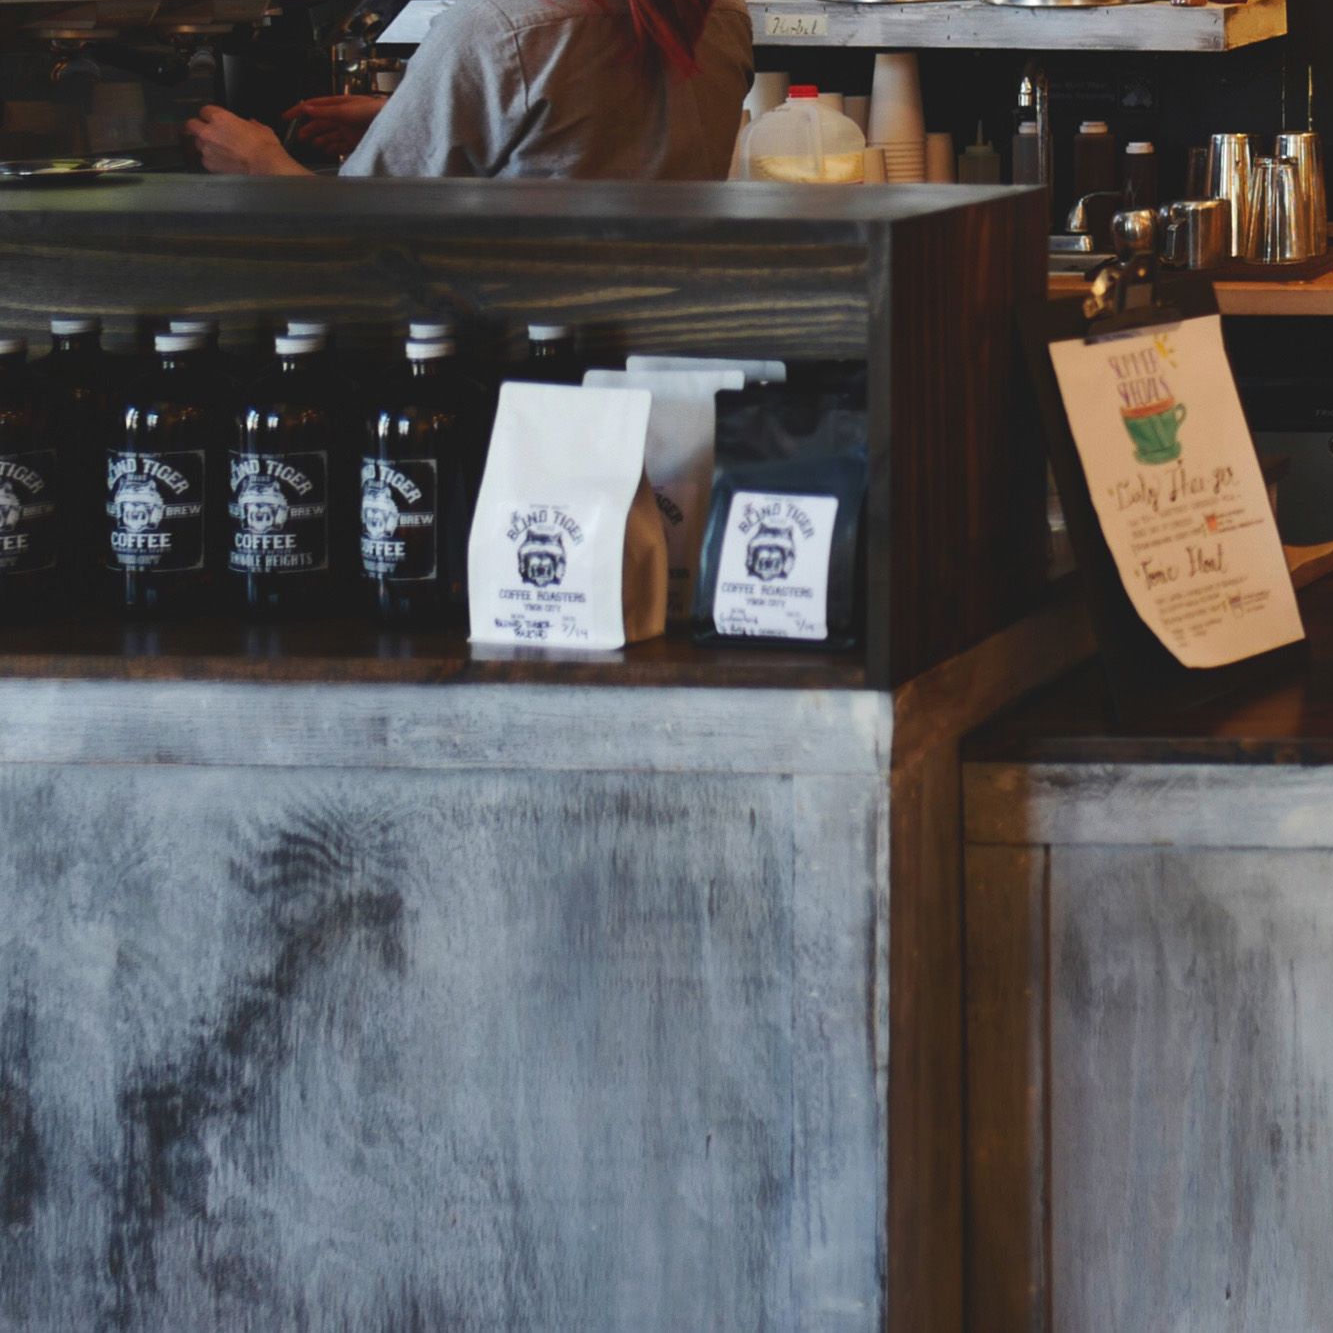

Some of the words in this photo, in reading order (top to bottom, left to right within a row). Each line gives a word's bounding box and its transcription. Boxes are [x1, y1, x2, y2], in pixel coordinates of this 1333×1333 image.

[142, 457, 190, 496] TIGER
[165, 504, 202, 517] BREW
[110, 532, 172, 549] COFFEE
